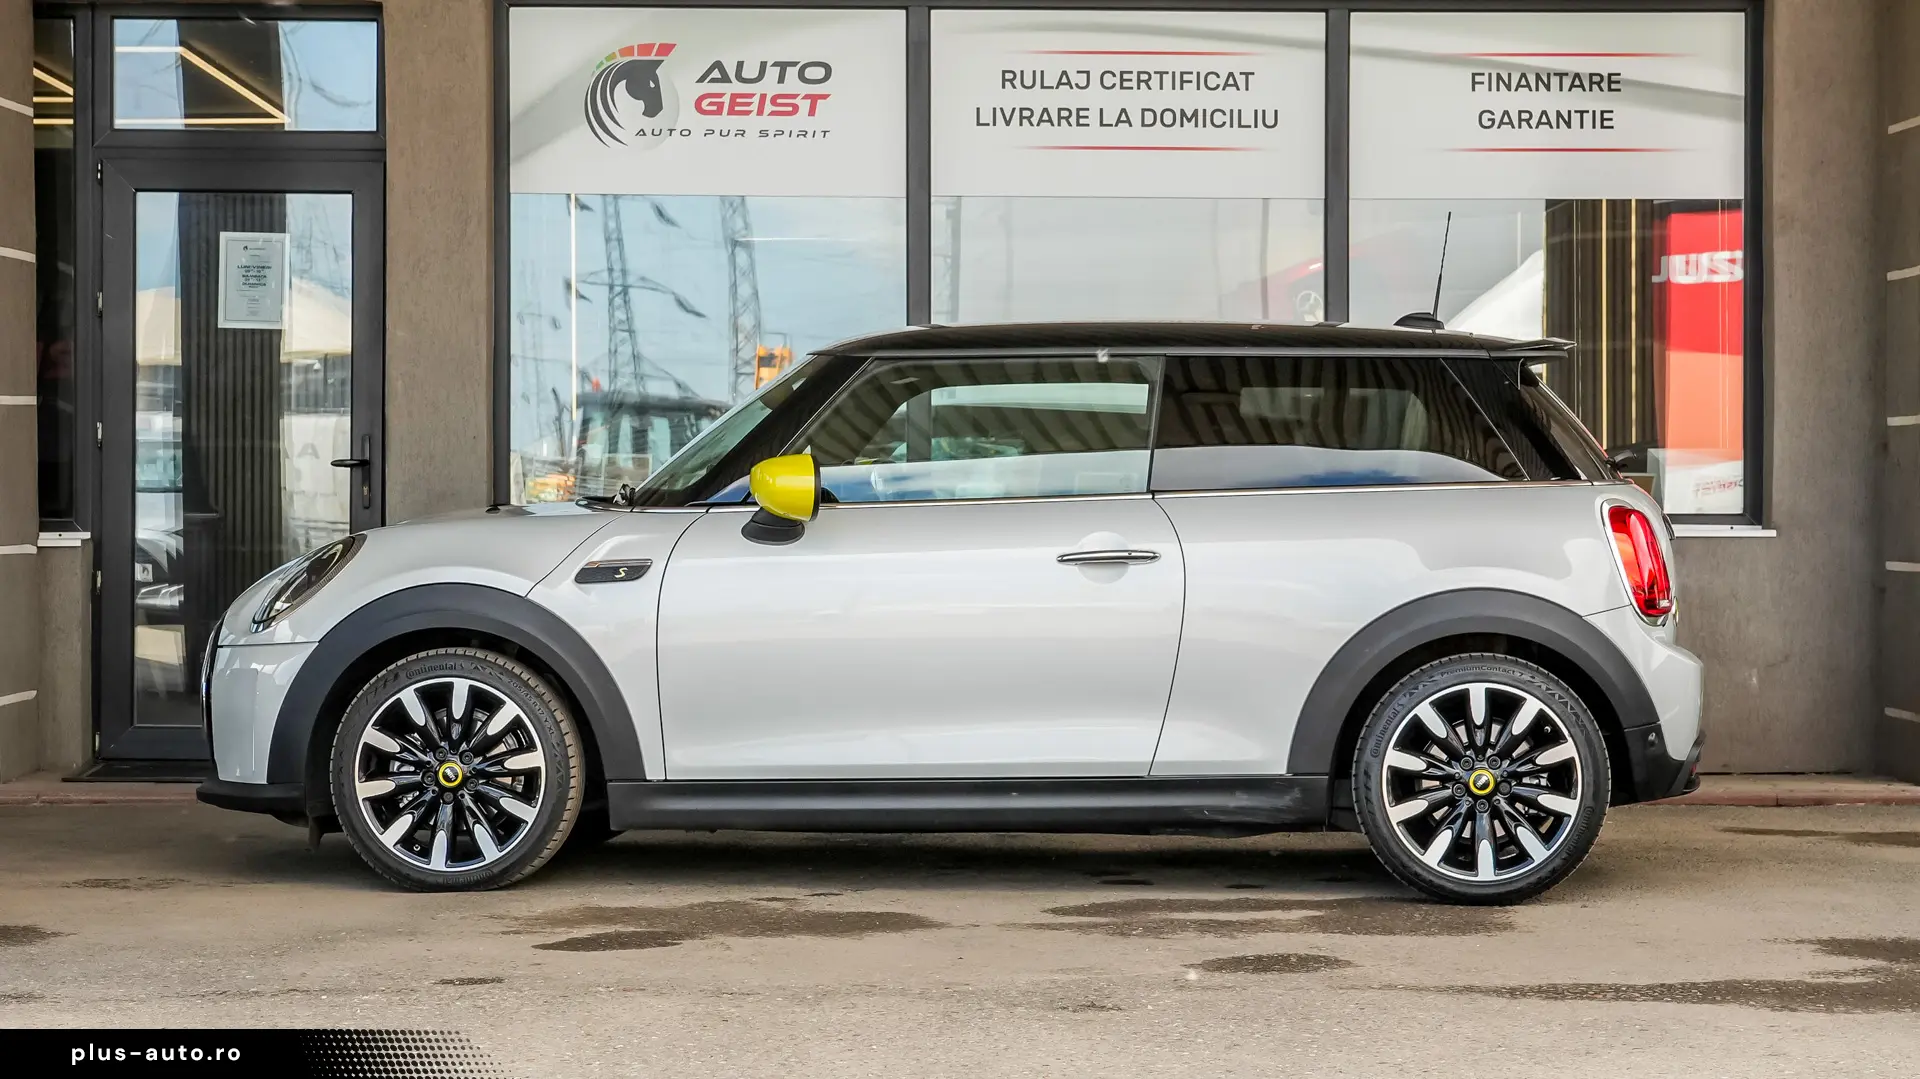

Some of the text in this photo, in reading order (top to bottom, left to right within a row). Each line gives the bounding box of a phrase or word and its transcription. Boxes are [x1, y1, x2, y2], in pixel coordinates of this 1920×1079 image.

[695, 60, 832, 84] AUTO
[1001, 69, 1255, 91] RULAJ CERTIFICAT
[1471, 72, 1622, 92] FINANTARE
[694, 93, 832, 117] GEIST
[976, 107, 1279, 129] LIVRARE LA DOMICILIU
[1478, 109, 1615, 129] GARANTIE
[635, 128, 831, 139] AUTO PUR SPIRIT
[614, 567, 628, 578] S
[406, 662, 457, 680] Continental
[1370, 709, 1401, 759] Continental
